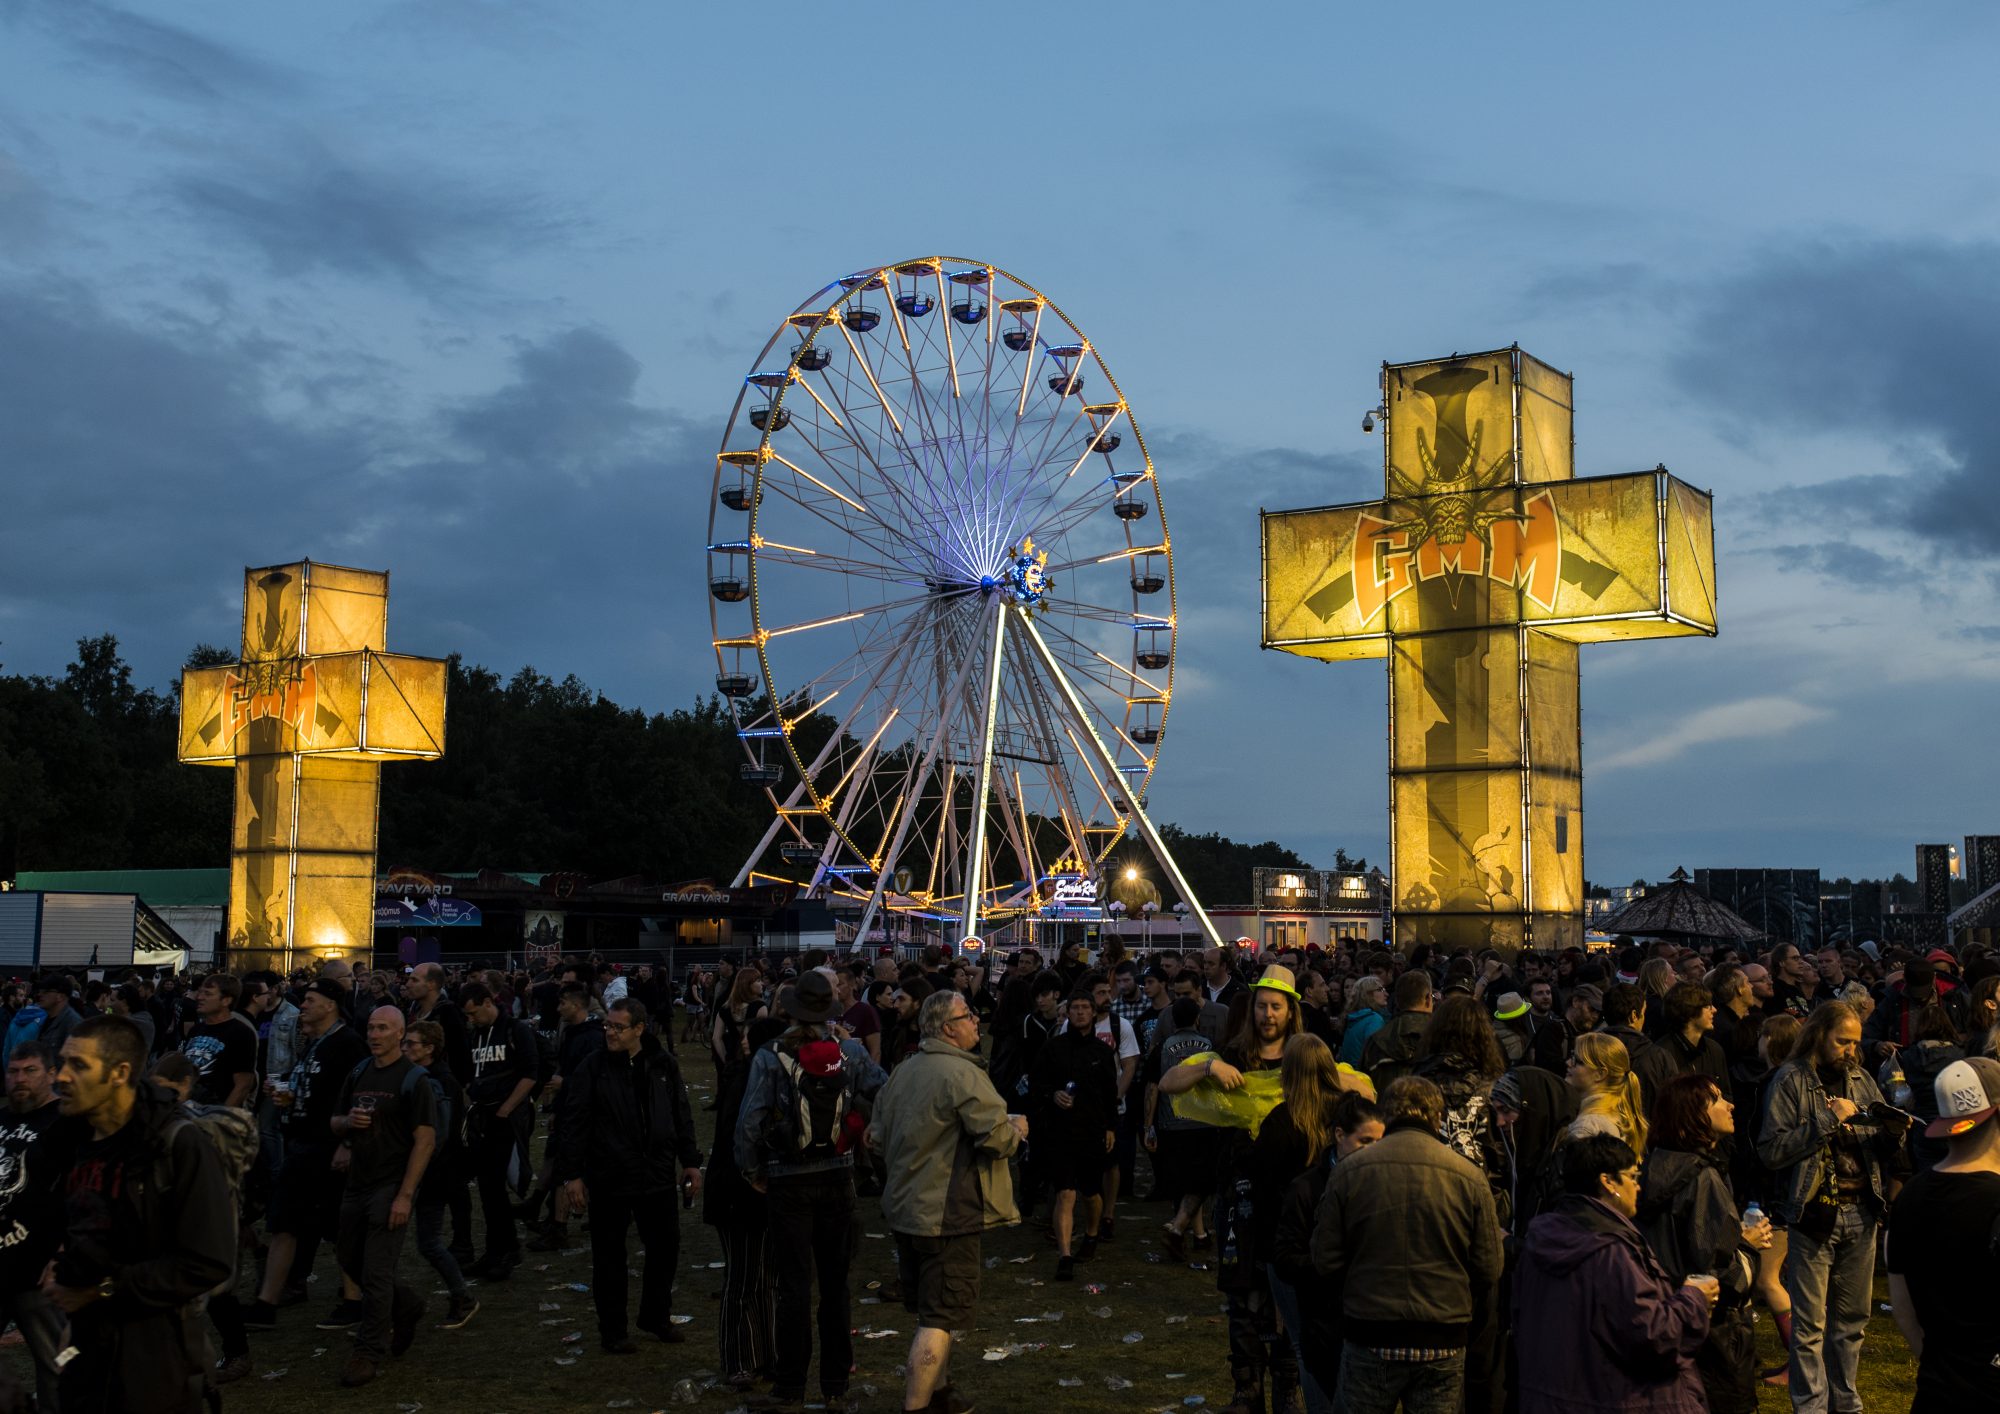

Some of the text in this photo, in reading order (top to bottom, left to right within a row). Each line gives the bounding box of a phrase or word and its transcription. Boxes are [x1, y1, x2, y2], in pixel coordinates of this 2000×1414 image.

[1352, 488, 1562, 628] GMM
[221, 660, 318, 752] GMM
[376, 883, 453, 895] RAVEYARD
[662, 892, 731, 904] GRAVEYARD
[375, 907, 400, 917] roximus
